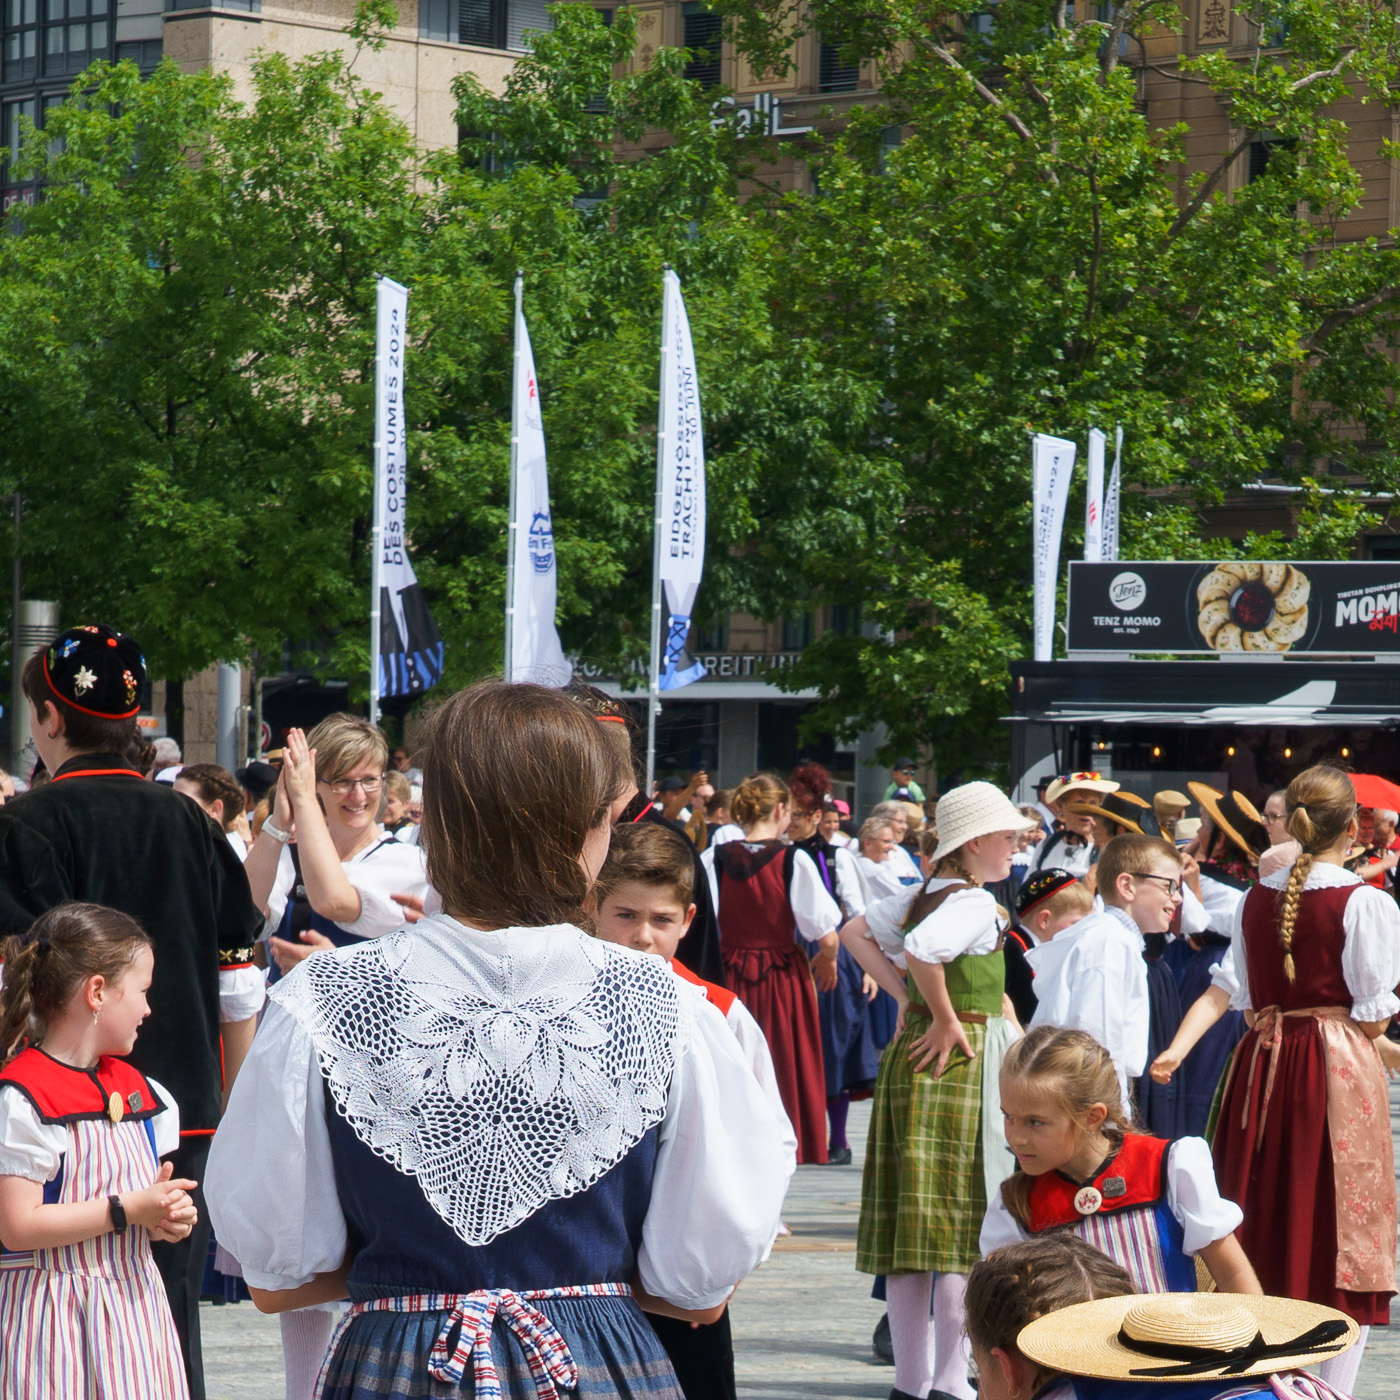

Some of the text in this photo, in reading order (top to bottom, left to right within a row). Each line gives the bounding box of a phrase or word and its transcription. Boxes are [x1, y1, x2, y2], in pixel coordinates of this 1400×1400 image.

[389, 308, 399, 368] 2024
[387, 375, 399, 513] COSTUMES
[1112, 579, 1143, 602] Tenz
[1337, 588, 1364, 599] TIBETAN
[1093, 616, 1162, 626] TENZ MOMO
